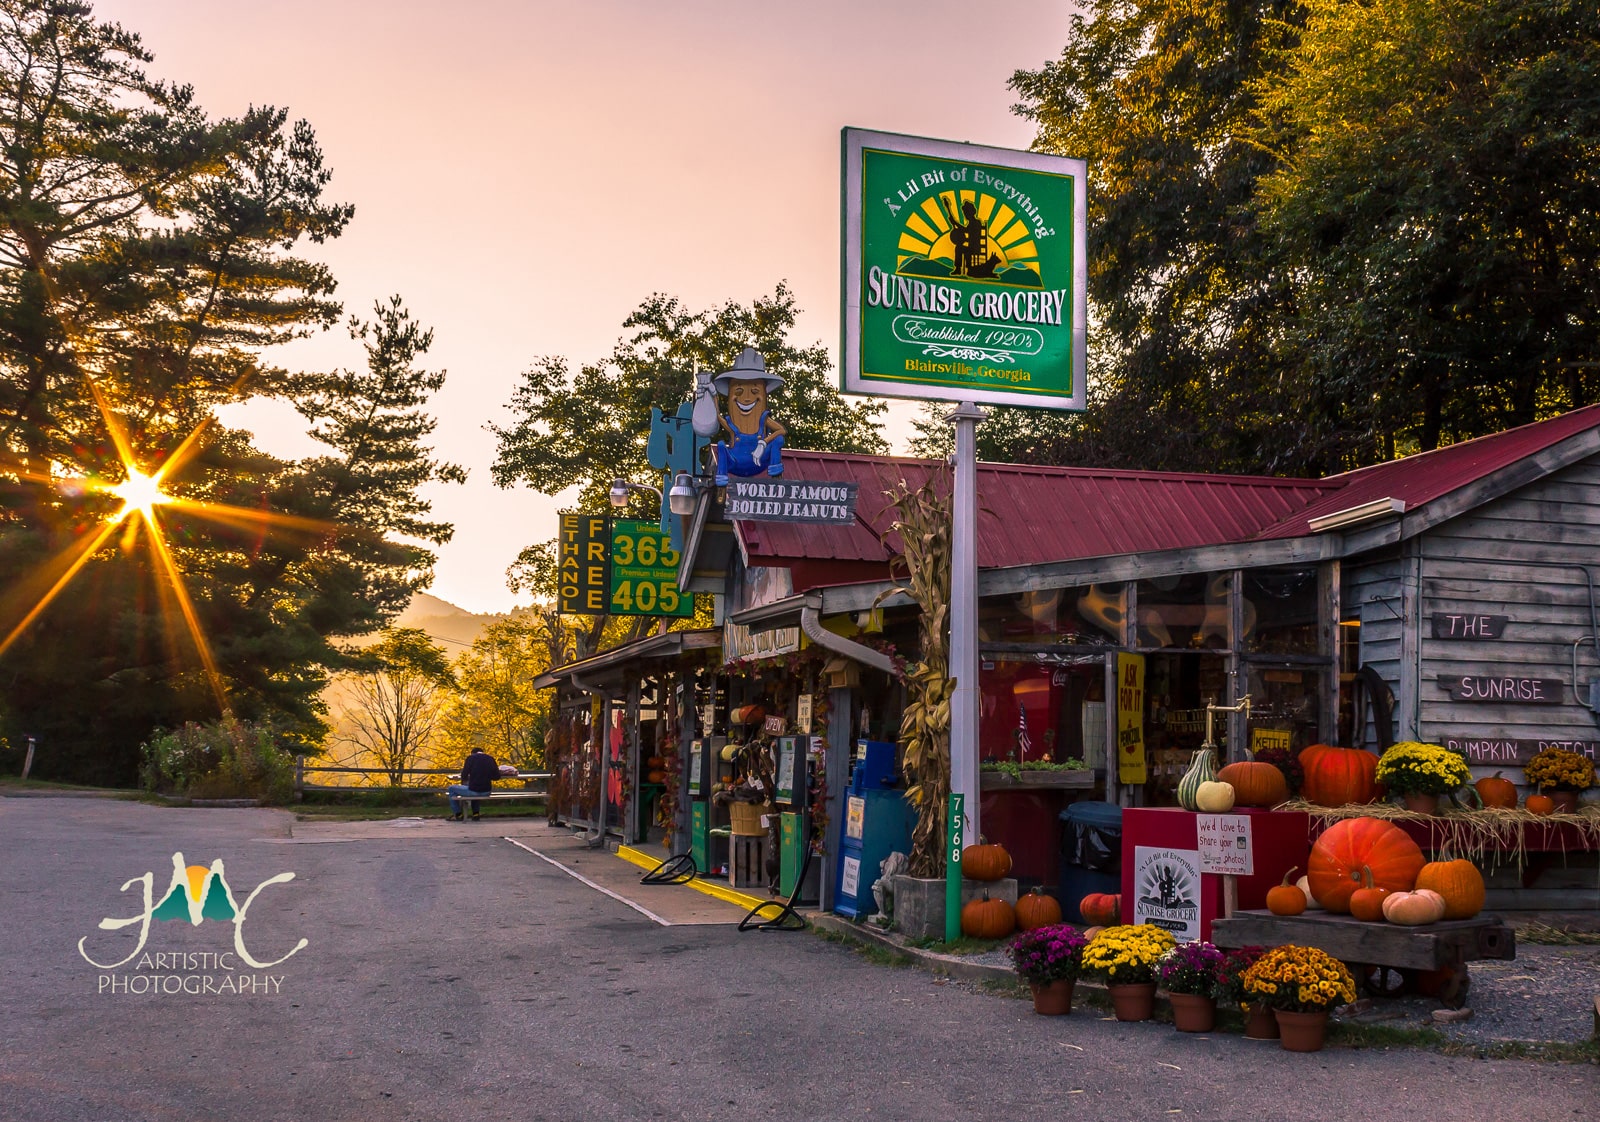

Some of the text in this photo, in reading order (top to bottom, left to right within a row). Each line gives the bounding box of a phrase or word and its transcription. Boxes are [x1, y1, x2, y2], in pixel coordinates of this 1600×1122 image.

[897, 178, 921, 203] Lil
[920, 169, 946, 188] Bit
[950, 167, 968, 182] of
[867, 265, 1067, 326] SUNRISE GROCERY
[904, 320, 1033, 348] Established 1920's
[977, 365, 1032, 382] Georgia
[736, 482, 848, 502] WORLD FAMOUS
[731, 499, 847, 519] BOILED PEANUTS
[613, 534, 680, 567] 365
[561, 515, 580, 613] ETHANOL
[587, 519, 606, 609] FREE
[621, 568, 651, 578] Premium
[612, 580, 679, 612] 405
[1446, 615, 1493, 637] THE
[1124, 663, 1138, 688] ASK
[1461, 676, 1544, 700] SUNRISE
[1120, 687, 1141, 712] FOR IT
[765, 717, 781, 732] OPEN
[1255, 736, 1288, 749] KETTLE
[952, 797, 962, 862] 7568
[1220, 817, 1235, 832] love
[1237, 819, 1246, 833] to
[1219, 835, 1233, 852] your
[1153, 852, 1162, 861] Bit
[1162, 851, 1170, 859] of
[1223, 851, 1247, 865] photos!
[1137, 901, 1198, 921] SUNRISE GROCERY
